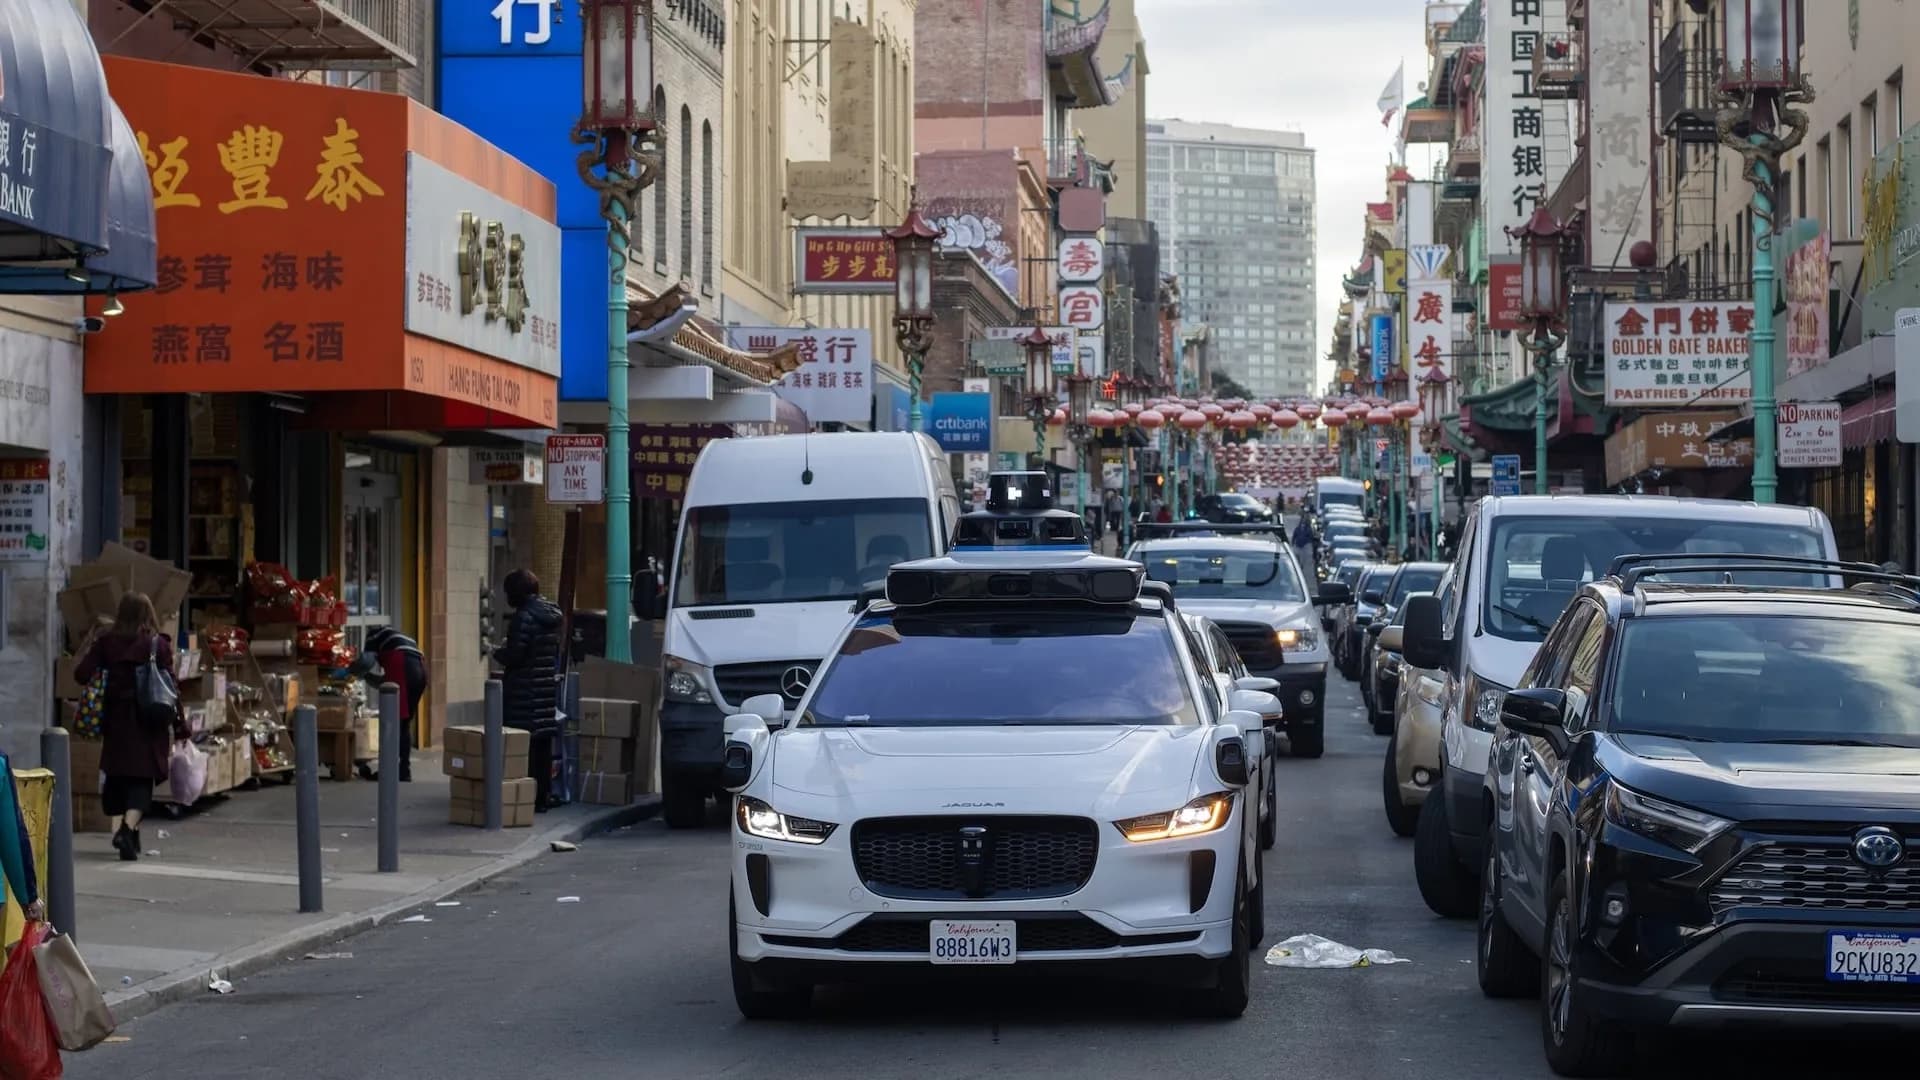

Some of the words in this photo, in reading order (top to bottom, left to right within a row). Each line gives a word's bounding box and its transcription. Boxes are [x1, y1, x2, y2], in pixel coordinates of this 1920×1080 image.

[1511, 0, 1544, 217] 中国工商银行
[820, 255, 894, 280] 步步高
[1614, 306, 1755, 336] 金門餅家
[263, 321, 345, 362] 名酒
[1612, 338, 1663, 356] GOLDEN
[1669, 338, 1701, 356] GATE
[1707, 337, 1750, 356] BAKER
[1412, 291, 1446, 411] 廣生
[1614, 388, 1689, 400] PASTRIES
[1700, 388, 1752, 399] COFFE
[1779, 405, 1797, 422] NO
[1799, 409, 1839, 421] PARKING
[935, 416, 988, 430] citibank
[551, 437, 600, 446] TOW-AWAY
[496, 452, 524, 461] TASTIN
[549, 447, 563, 462] NO
[565, 450, 601, 462] STOPPING
[564, 465, 586, 477] ANY
[563, 478, 588, 490] TIME
[948, 923, 998, 937] California
[936, 937, 1011, 957] 88816W3
[1849, 937, 1905, 950] California
[1835, 951, 1918, 975] 9CKU832
